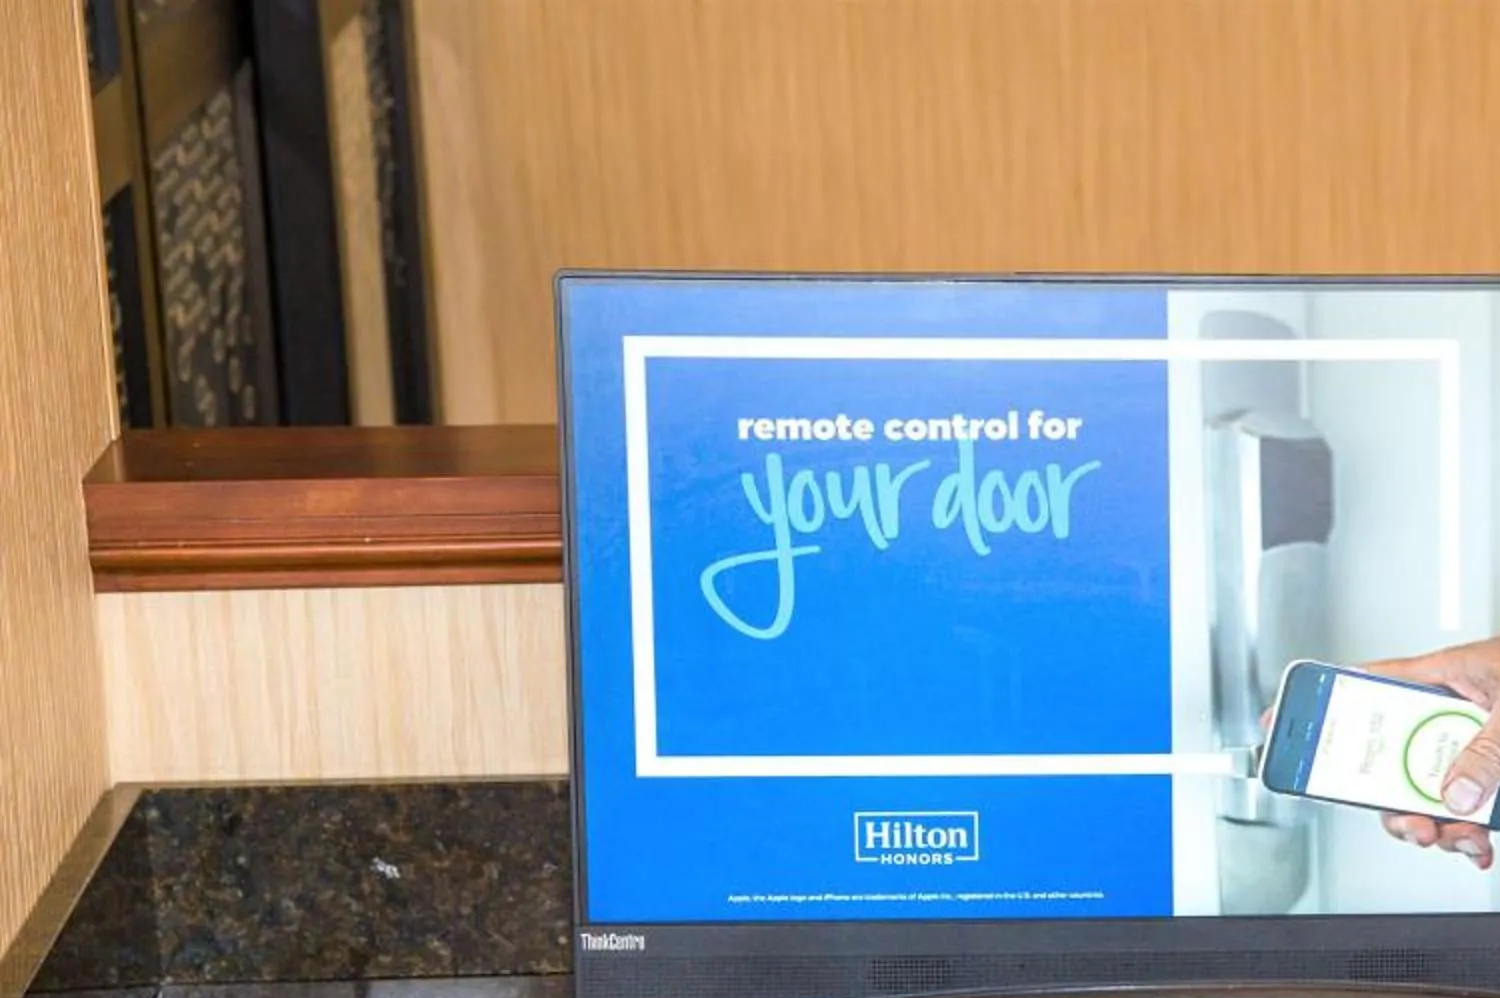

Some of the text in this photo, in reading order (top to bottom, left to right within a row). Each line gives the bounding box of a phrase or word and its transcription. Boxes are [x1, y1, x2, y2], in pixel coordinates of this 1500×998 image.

[738, 410, 1082, 441] remote control for
[700, 438, 1102, 640] your door
[864, 821, 969, 849] Hilton
[880, 852, 954, 865] HONORS
